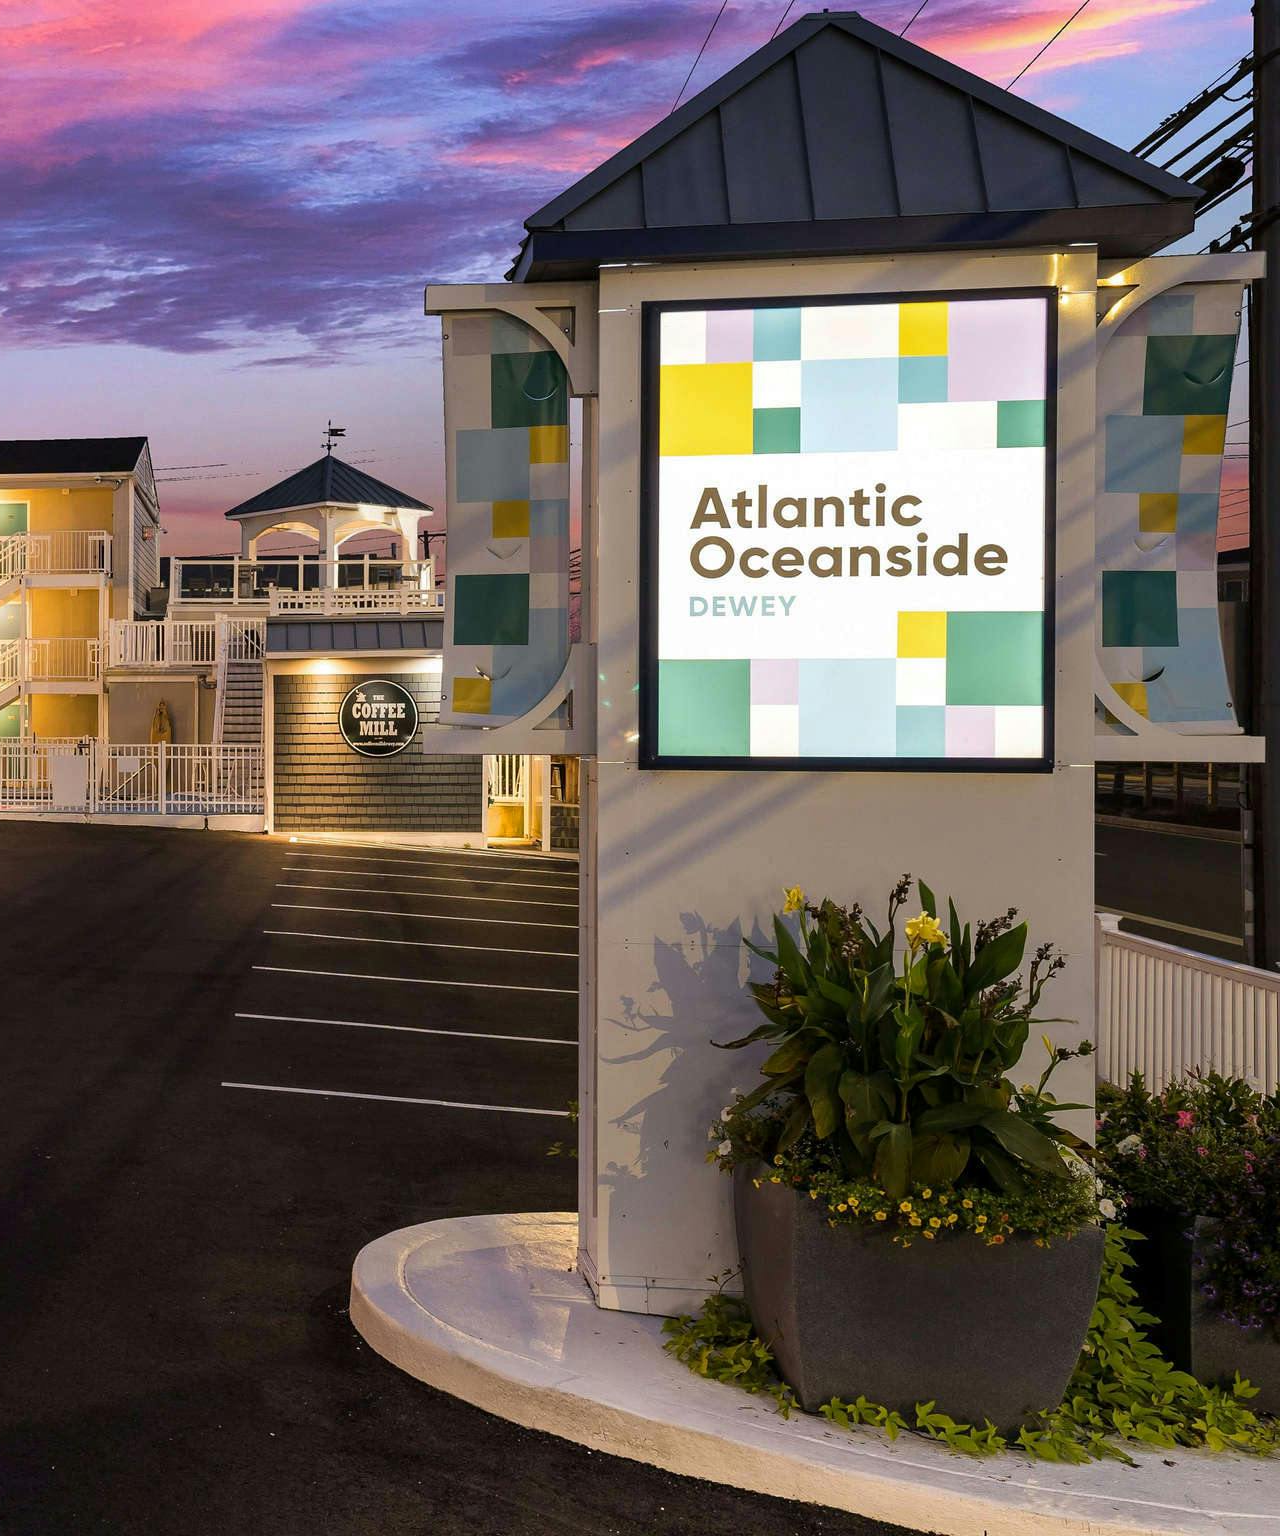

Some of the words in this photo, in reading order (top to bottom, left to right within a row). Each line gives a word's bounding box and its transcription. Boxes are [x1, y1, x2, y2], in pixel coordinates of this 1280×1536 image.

[689, 482, 923, 530] Atlantic
[689, 532, 1009, 580] Oceanside
[688, 595, 797, 617] DEWEY
[352, 703, 406, 719] COFFEE
[359, 720, 398, 736] MILL
